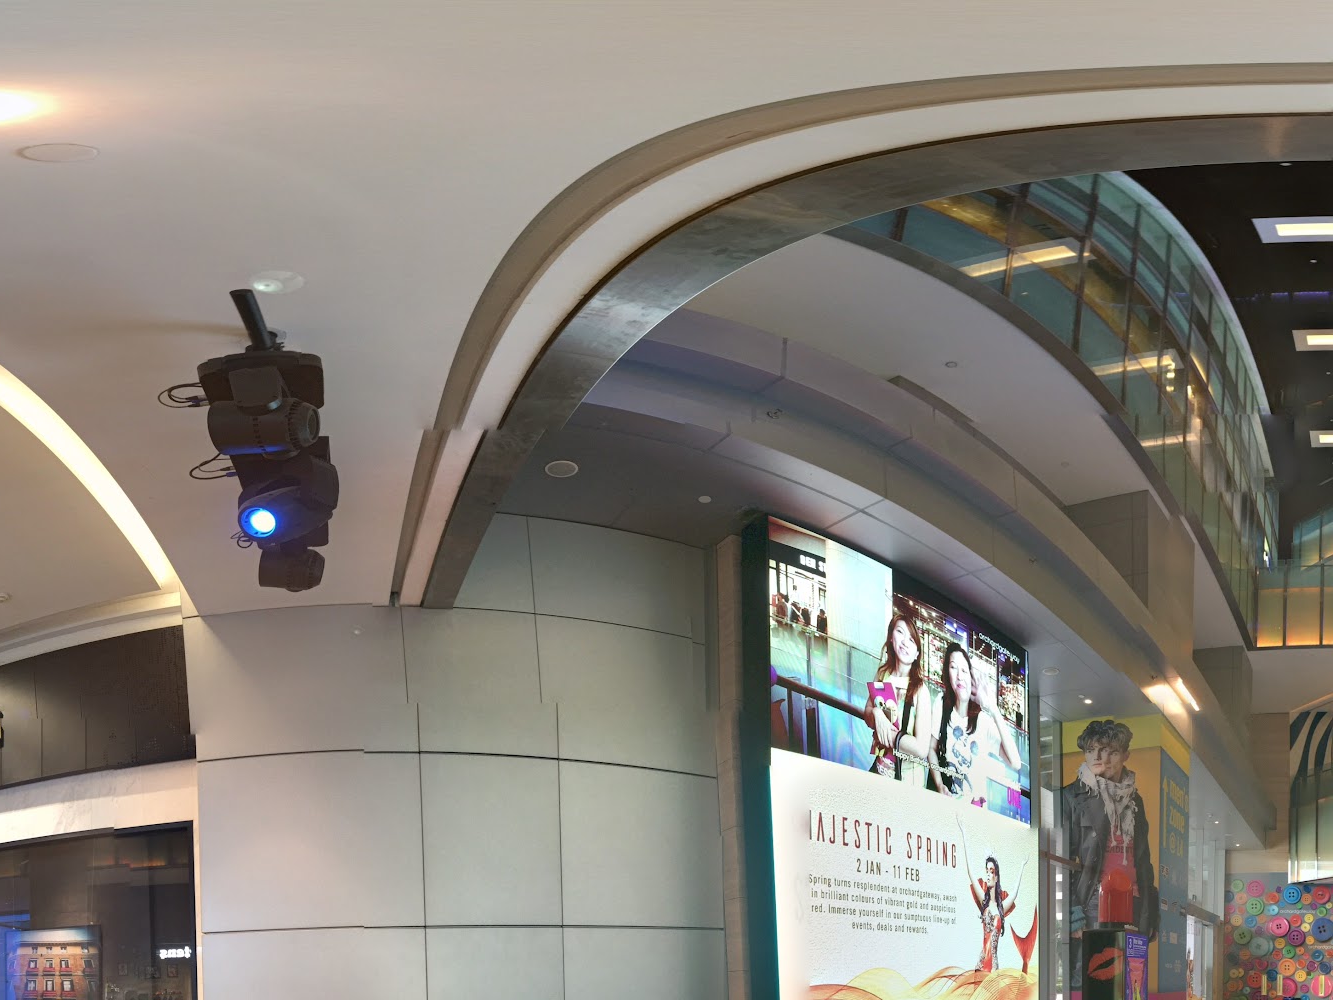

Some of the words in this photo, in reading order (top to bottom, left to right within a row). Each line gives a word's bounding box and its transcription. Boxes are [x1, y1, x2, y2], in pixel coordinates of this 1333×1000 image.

[906, 832, 957, 868] SPRING
[856, 858, 861, 873] 2
[866, 861, 881, 876] JAN
[893, 865, 901, 879] 11
[905, 867, 920, 882] FEB
[809, 873, 832, 888] Spring
[834, 878, 851, 888] turns
[853, 881, 890, 893] resplendent
[892, 886, 898, 894] at
[811, 888, 818, 898] in
[821, 889, 849, 901] brilliant
[851, 894, 875, 904] colours
[876, 896, 883, 905] of
[885, 897, 905, 908] vibrant
[906, 900, 918, 910] gold
[920, 902, 929, 910] and
[811, 904, 826, 913] red.
[828, 904, 857, 916] Immerse
[859, 908, 884, 918] yourself
[886, 909, 892, 918] in
[893, 912, 903, 920] our
[852, 921, 875, 932] events,
[876, 922, 893, 932] deals
[895, 924, 905, 933] and
